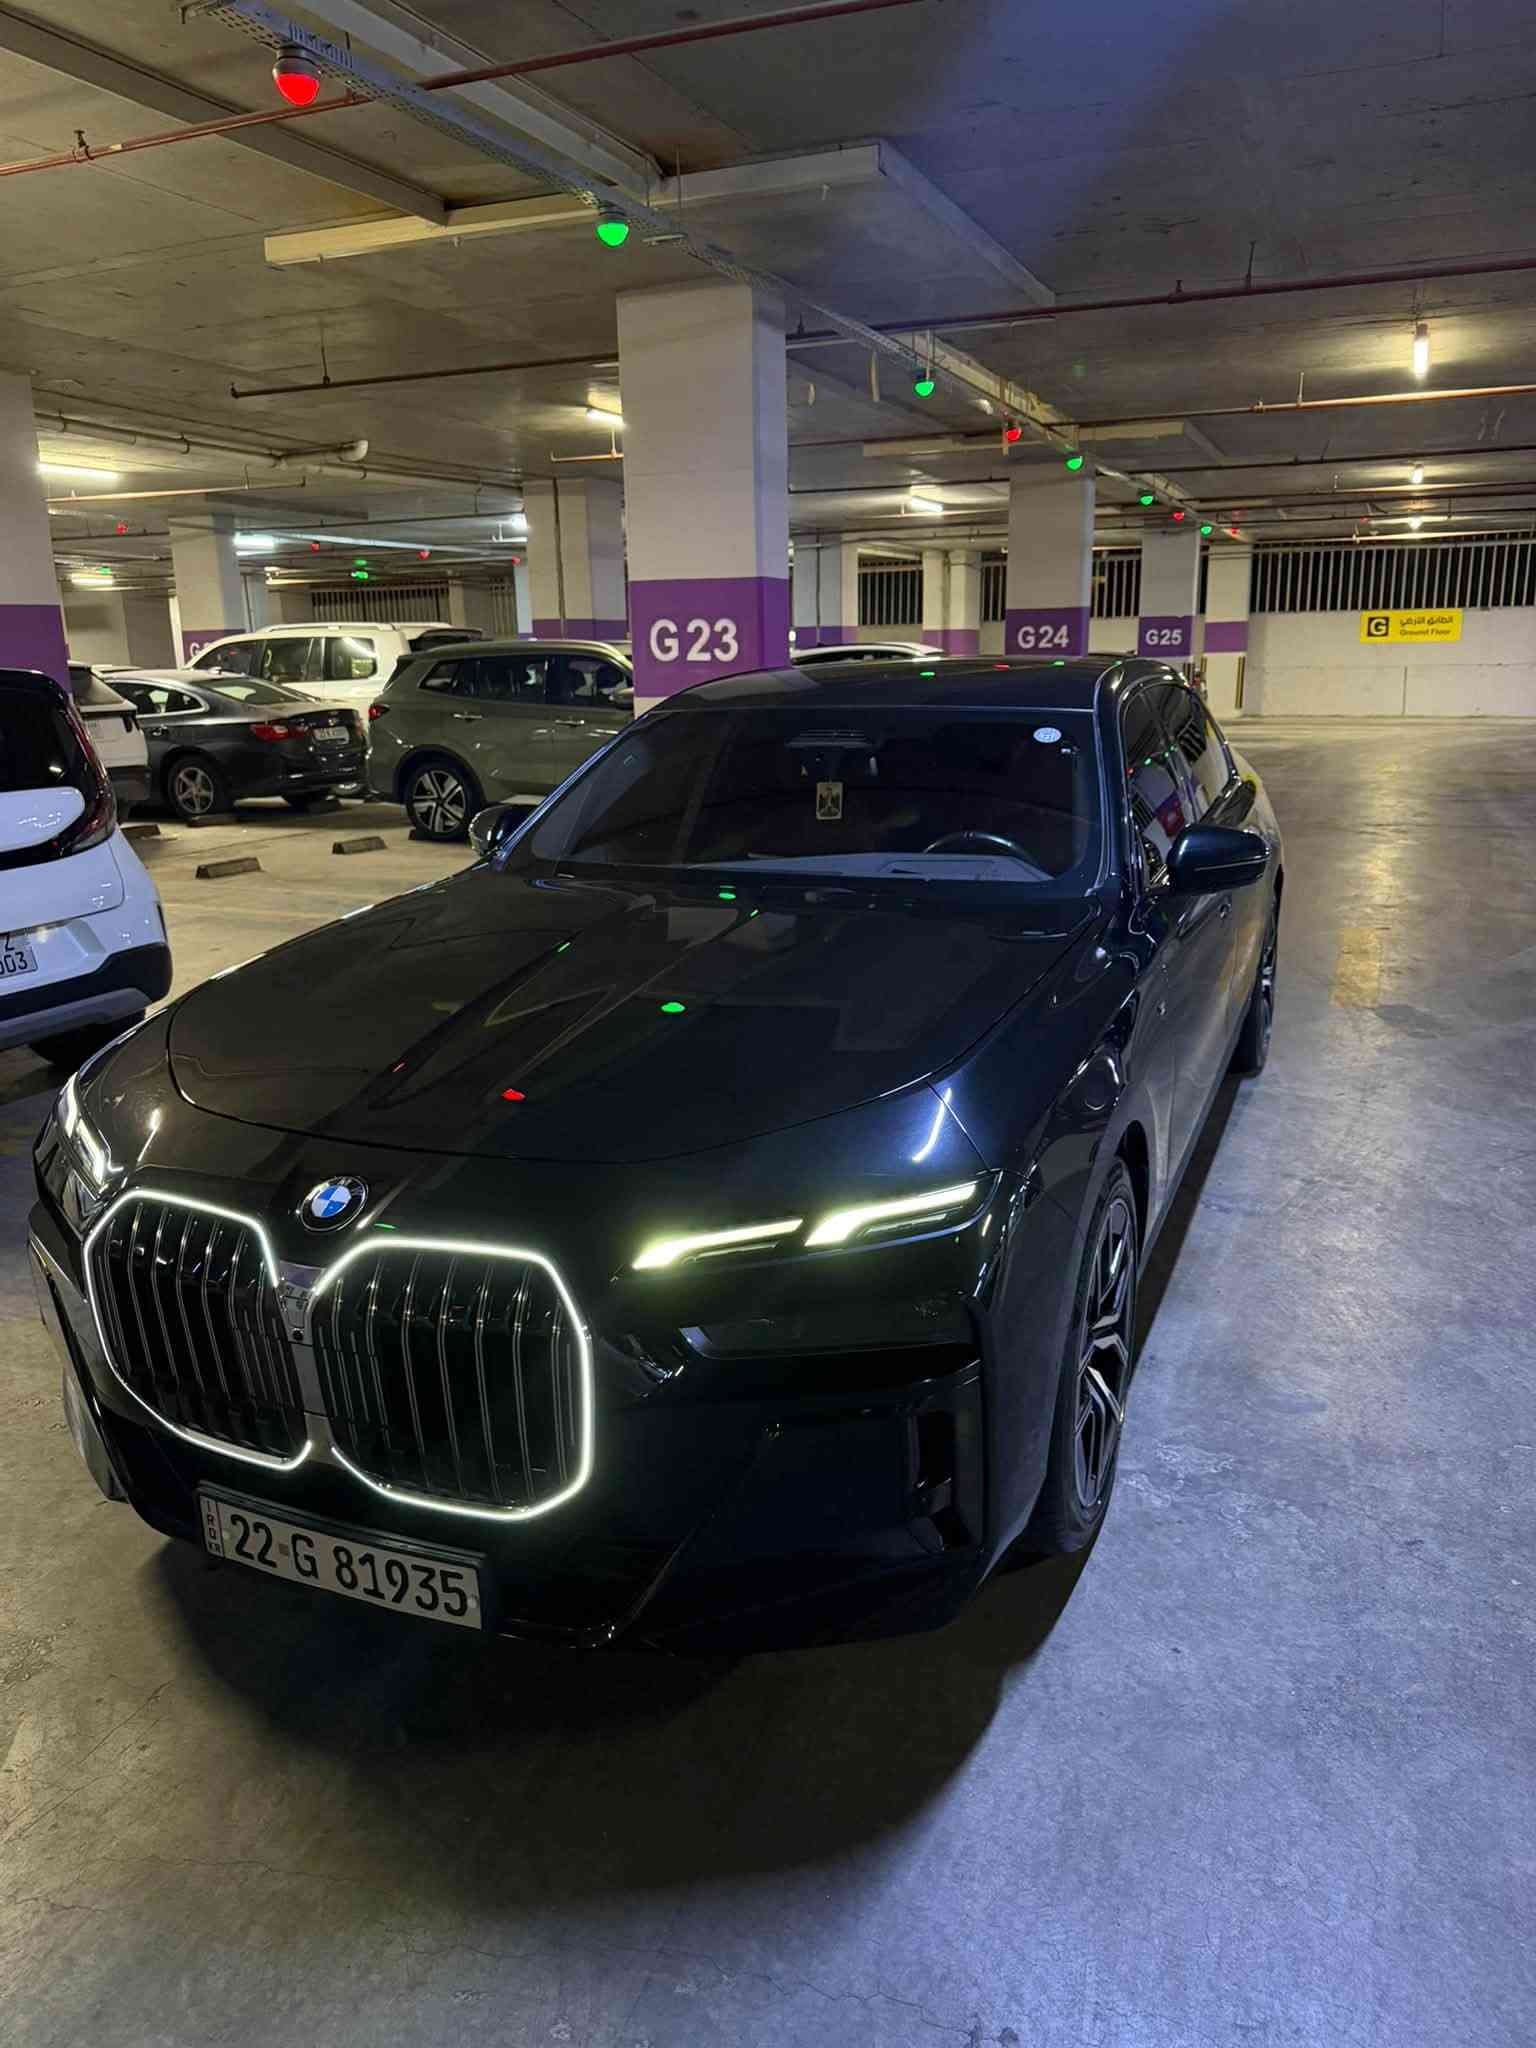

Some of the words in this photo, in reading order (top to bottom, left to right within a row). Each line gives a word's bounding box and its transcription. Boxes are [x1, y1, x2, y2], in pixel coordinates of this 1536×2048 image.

[1017, 625, 1070, 649] G24
[1145, 629, 1182, 645] G25
[1370, 618, 1387, 636] G
[650, 618, 738, 662] G23
[230, 1513, 278, 1568] 22
[290, 1532, 319, 1579] G
[332, 1545, 468, 1617] 81935
